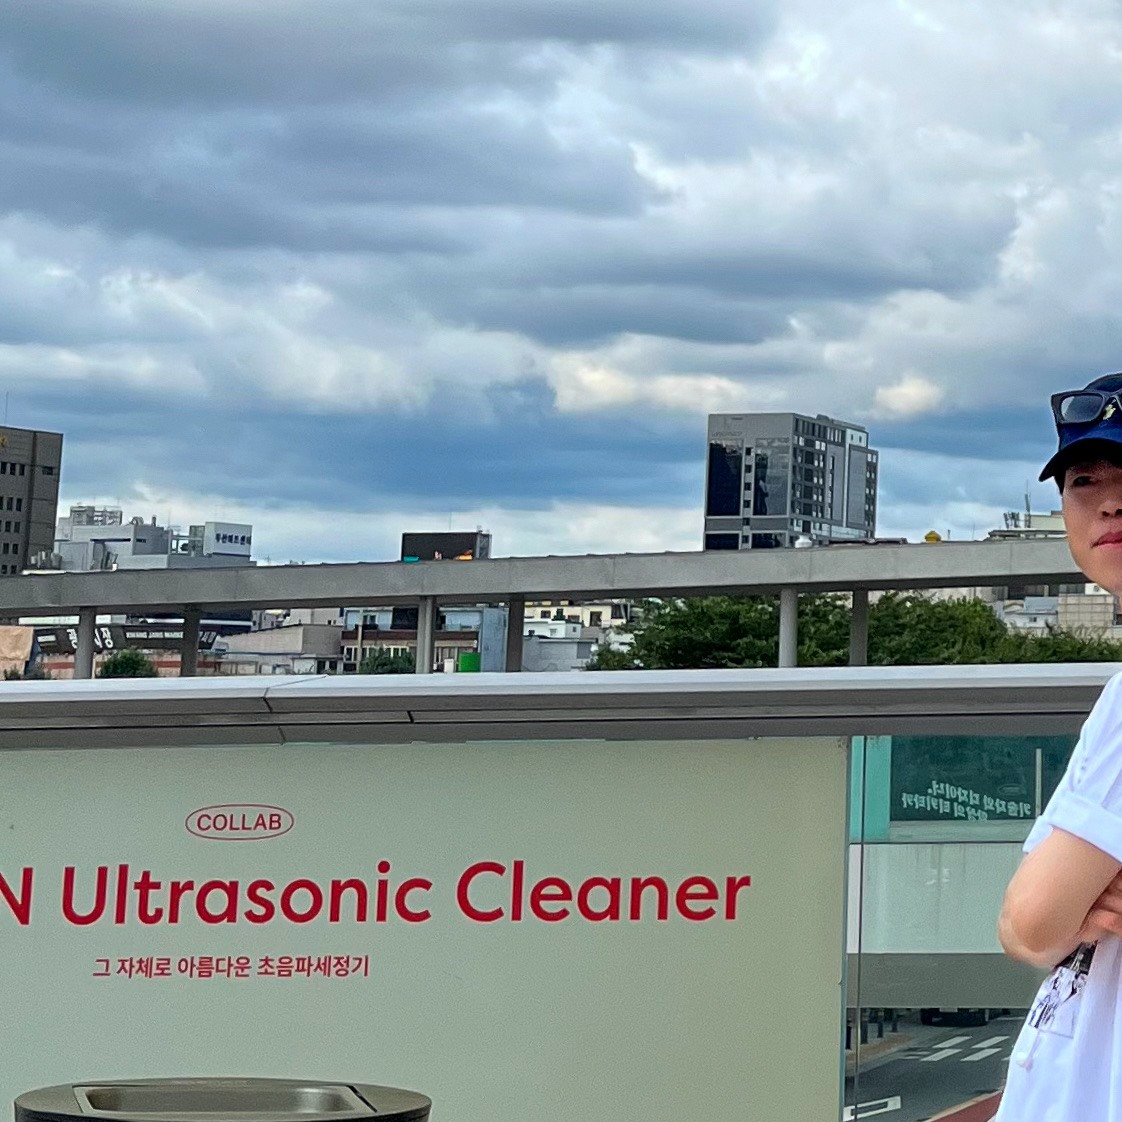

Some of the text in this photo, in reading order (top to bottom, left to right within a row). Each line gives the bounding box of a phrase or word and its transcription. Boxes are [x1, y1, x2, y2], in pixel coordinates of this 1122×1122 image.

[196, 812, 283, 832] COLLAB
[62, 860, 434, 926] Ultrasonic
[456, 860, 751, 922] Cleaner
[92, 954, 370, 979] 그 자체로 아름다운 초음파세정기
